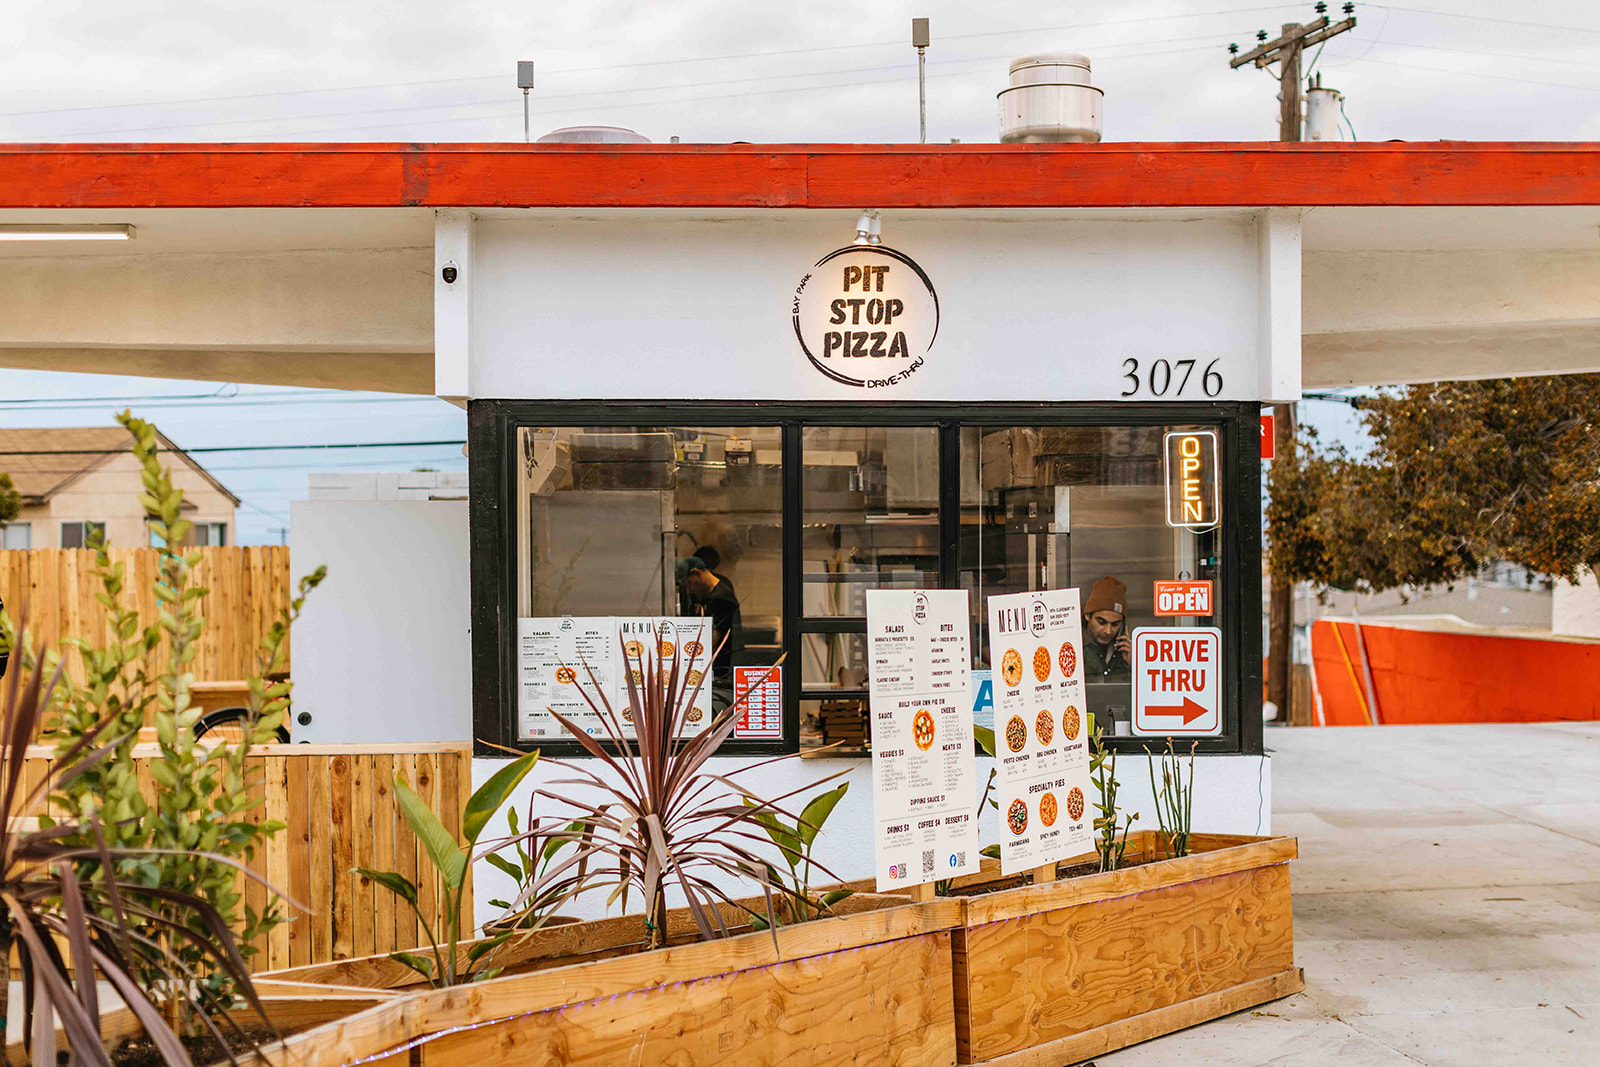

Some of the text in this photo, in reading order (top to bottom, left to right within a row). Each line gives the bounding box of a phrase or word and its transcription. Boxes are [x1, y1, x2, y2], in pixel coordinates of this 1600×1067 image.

[843, 265, 890, 292] PIT
[792, 273, 812, 314] BAY PARK
[829, 298, 904, 325] STOP
[823, 331, 909, 358] PIZZA
[867, 356, 925, 389] DRIVE-THRU
[1121, 358, 1223, 397] 3076
[1180, 437, 1202, 521] OPEN
[1158, 592, 1208, 612] OPEN
[1034, 605, 1042, 613] PIT
[998, 607, 1027, 633] MENU
[1033, 614, 1044, 622] STOP
[623, 622, 651, 634] MENU
[885, 625, 904, 633] SALADS
[940, 624, 953, 632] BITES
[1032, 622, 1045, 631] PIZZA
[1145, 639, 1209, 662] DRIVE
[1147, 669, 1206, 692] THRU
[972, 679, 994, 711] A
[1006, 689, 1020, 697] CHEESE
[878, 711, 893, 720] SAUCE
[940, 706, 956, 714] CHEESE
[942, 743, 956, 751] MEATS
[880, 750, 898, 758] VEGGIES
[1028, 778, 1066, 794] SPECIALTY PIES
[926, 795, 940, 804] SAUCE
[917, 819, 934, 829] COFFEE
[945, 814, 963, 825] DESSERT
[887, 824, 903, 834] DRINKS
